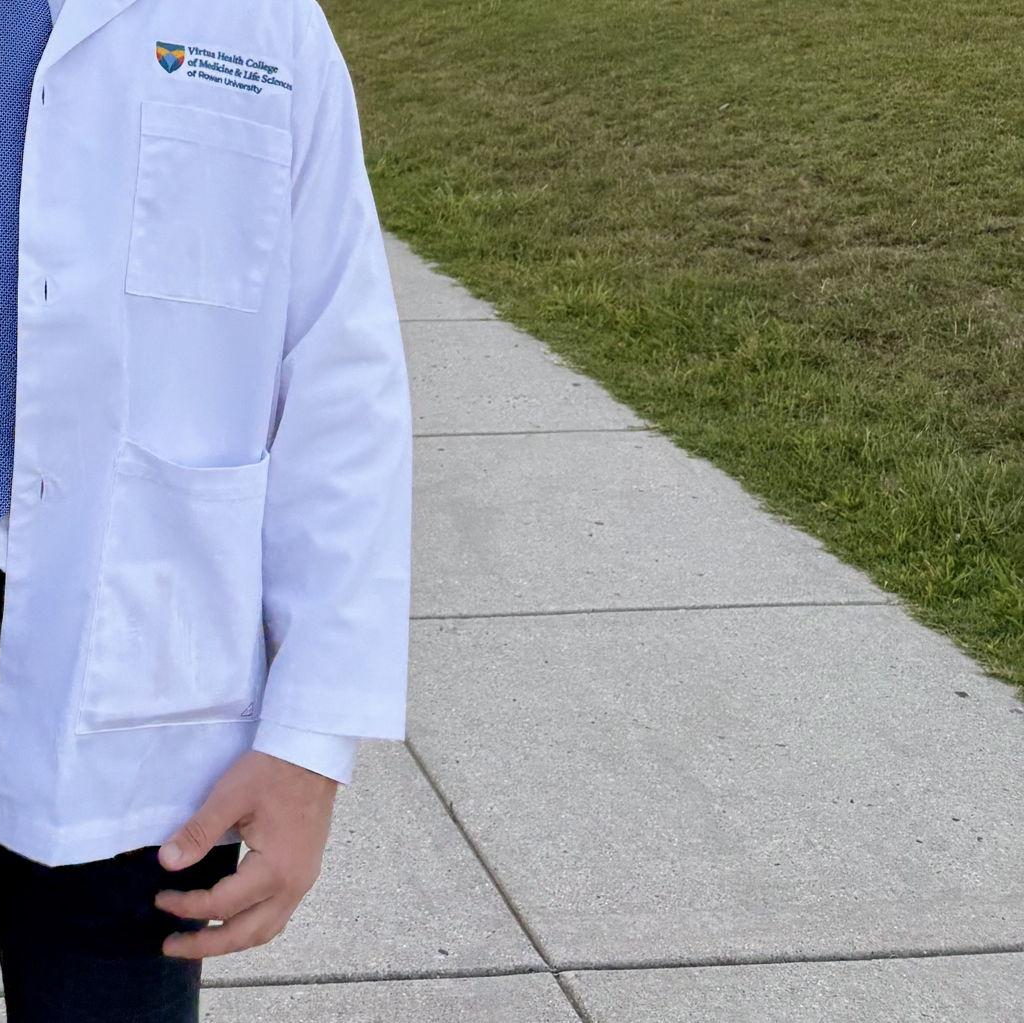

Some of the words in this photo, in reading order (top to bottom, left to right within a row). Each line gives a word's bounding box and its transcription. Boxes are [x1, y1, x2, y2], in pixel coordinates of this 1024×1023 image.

[187, 58, 198, 67] of
[199, 59, 233, 75] Medicine
[234, 67, 242, 78] &
[243, 70, 261, 82] Life
[188, 47, 216, 58] Virtua
[217, 51, 244, 66] Health
[246, 59, 278, 74] College
[198, 71, 222, 83] Rowan
[224, 78, 262, 94] University
